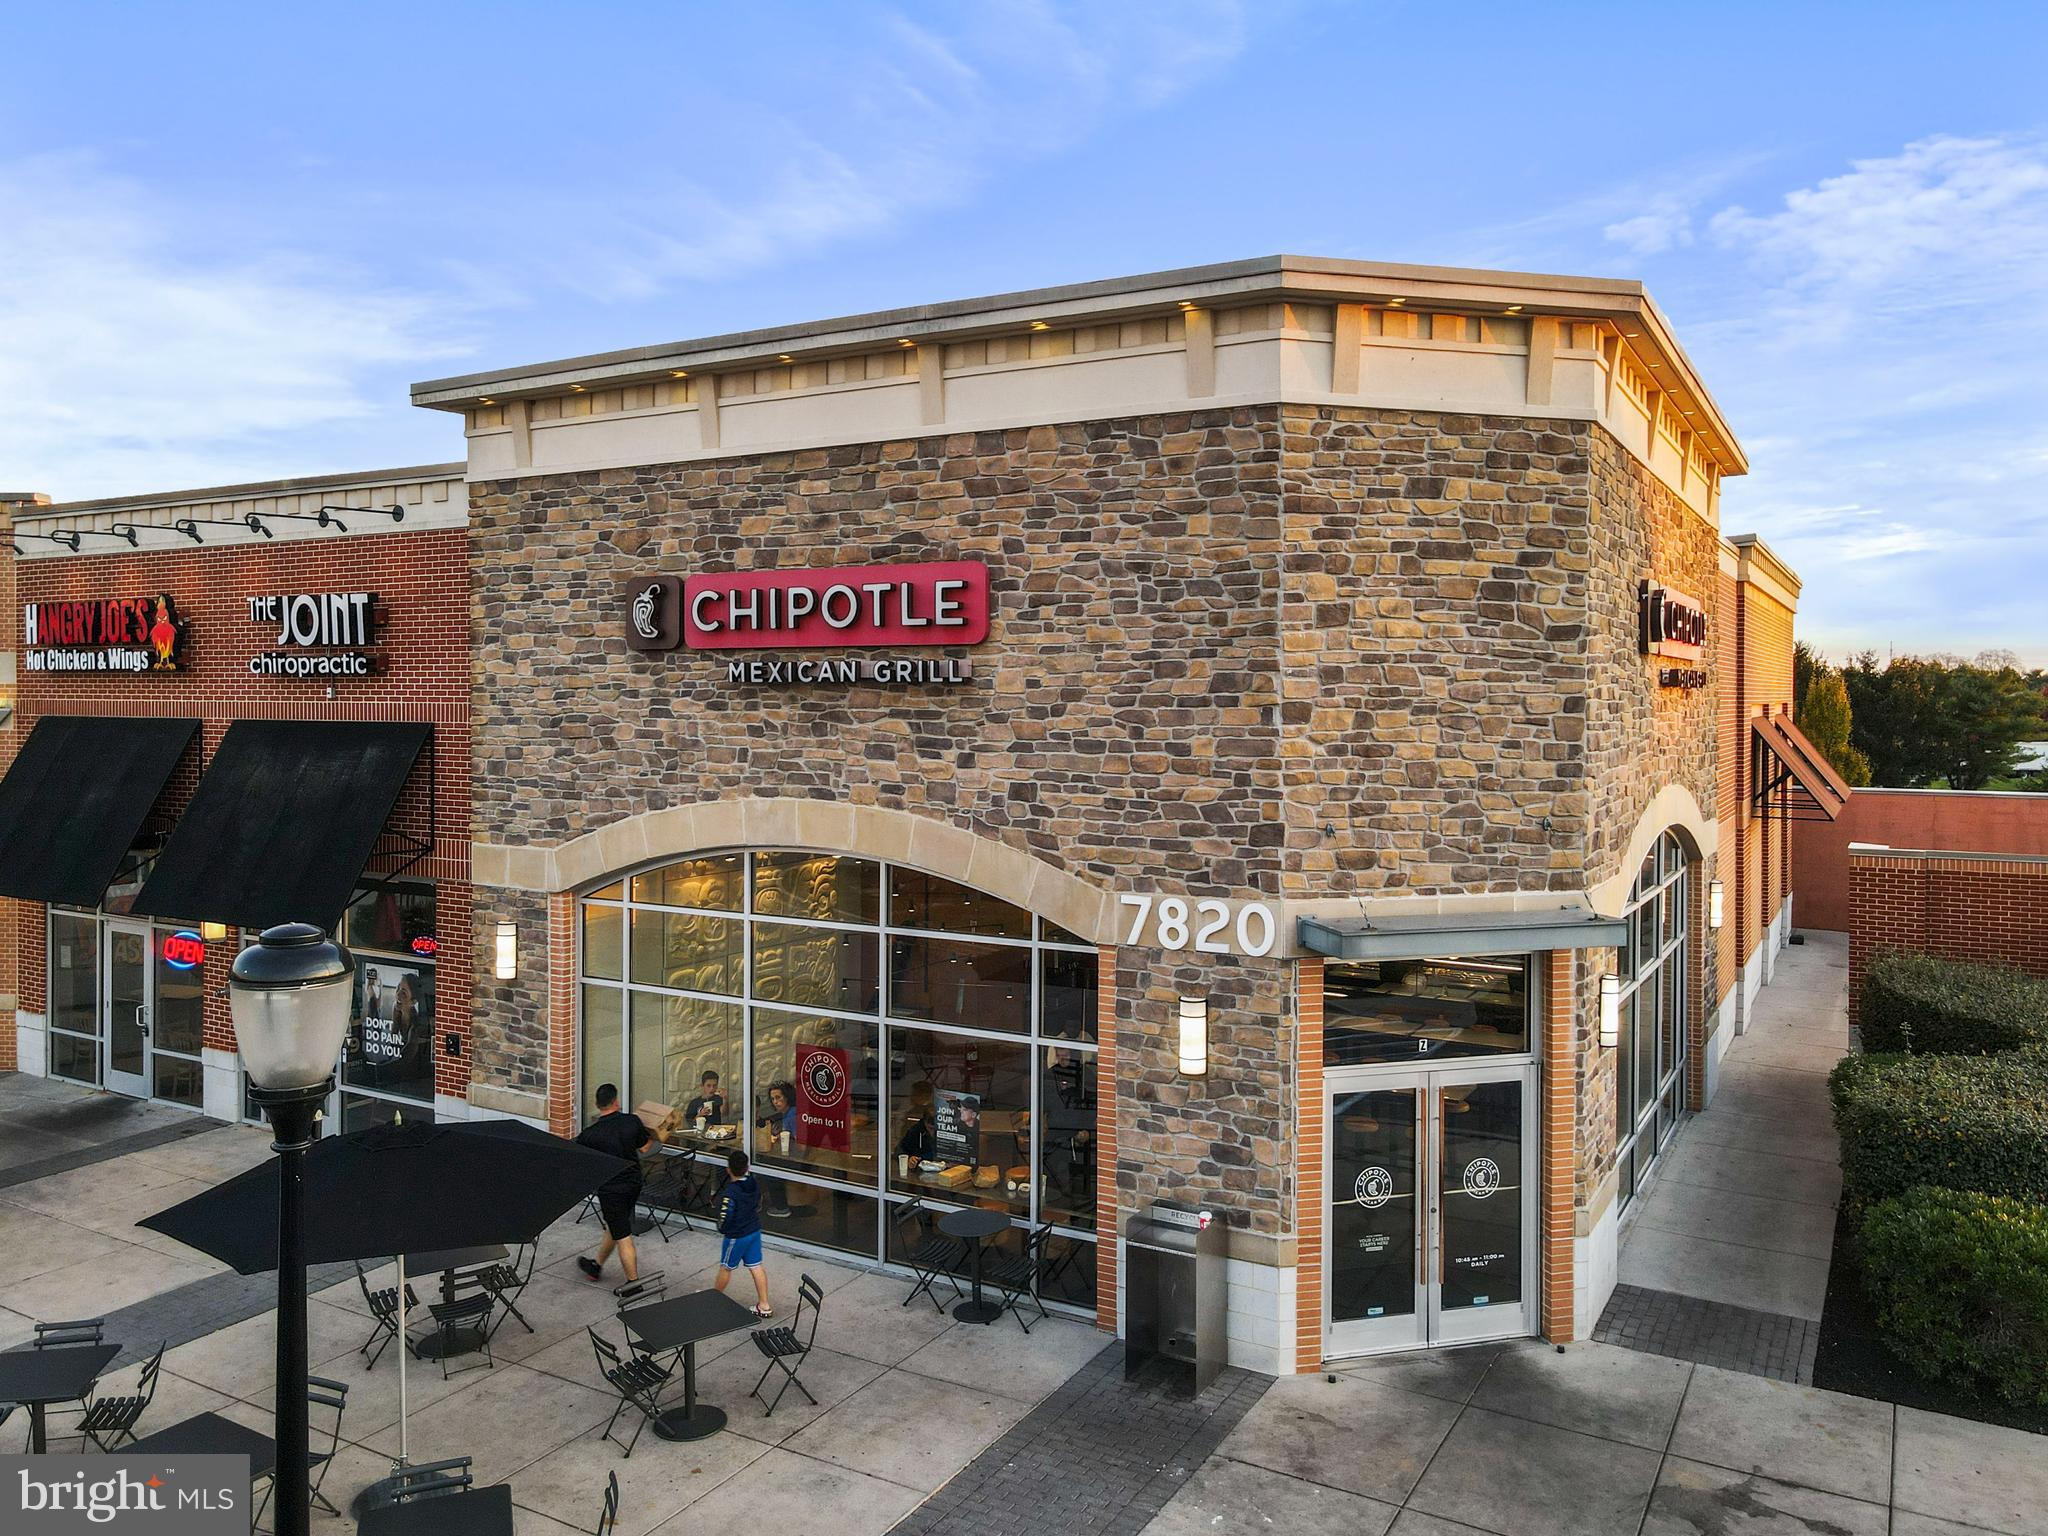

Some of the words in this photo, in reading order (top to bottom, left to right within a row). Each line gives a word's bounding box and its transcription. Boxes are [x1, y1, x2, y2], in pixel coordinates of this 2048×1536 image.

[692, 580, 964, 632] CHIPOTLE
[25, 601, 95, 645] HANGRY
[99, 598, 149, 644] JOE'S
[247, 596, 276, 621] THE
[278, 594, 368, 646] JOINT
[26, 650, 46, 670] Hot
[47, 648, 96, 671] Chicken
[97, 651, 107, 670] &
[108, 647, 149, 672] Wings
[249, 652, 367, 678] chiropractic
[728, 660, 857, 684] MEXICAN
[873, 659, 963, 683] GRILL
[1120, 894, 1275, 957] 7820
[163, 937, 204, 964] OPEN
[412, 938, 437, 950] OPEN
[365, 1017, 394, 1031] DON'T
[365, 1030, 380, 1041] DO
[381, 1032, 404, 1046] PAIN.
[365, 1042, 380, 1054] DO
[381, 1044, 402, 1058] YOU.
[804, 1055, 842, 1078] CHIPOTLE
[937, 1106, 955, 1116] JOIN
[937, 1114, 953, 1124] OUR
[802, 1113, 823, 1124] Open
[825, 1119, 833, 1127] to
[836, 1120, 844, 1129] 11
[937, 1123, 958, 1133] TEAM
[1467, 1160, 1497, 1177] CHIPOTLE
[1358, 1169, 1389, 1186] CHIPOTLE
